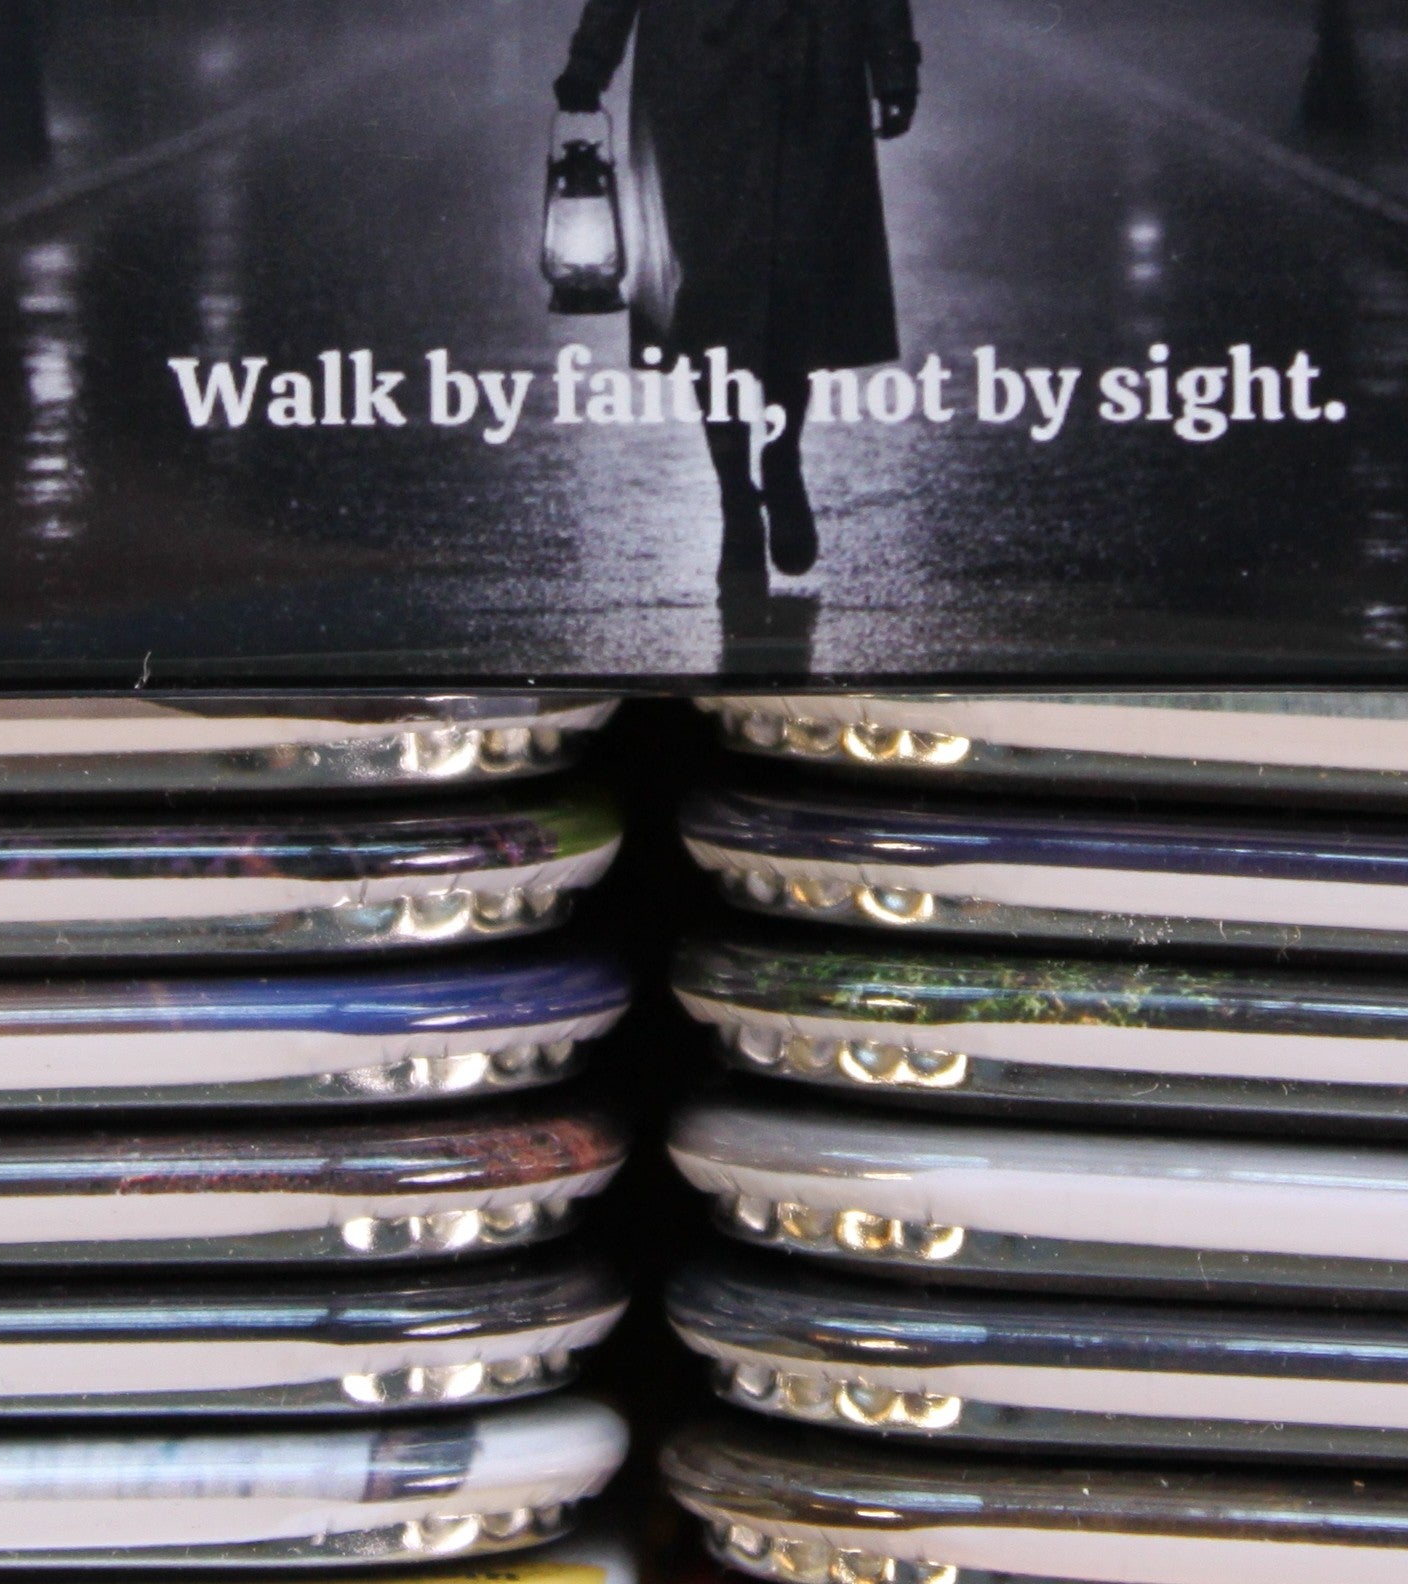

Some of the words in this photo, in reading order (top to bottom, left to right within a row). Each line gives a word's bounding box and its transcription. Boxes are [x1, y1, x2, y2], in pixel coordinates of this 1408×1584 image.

[169, 349, 407, 428] Walk
[425, 349, 534, 443] by
[553, 344, 789, 444] faith,
[808, 352, 954, 422] not
[976, 344, 1081, 442] by
[1098, 344, 1349, 442] sight.
